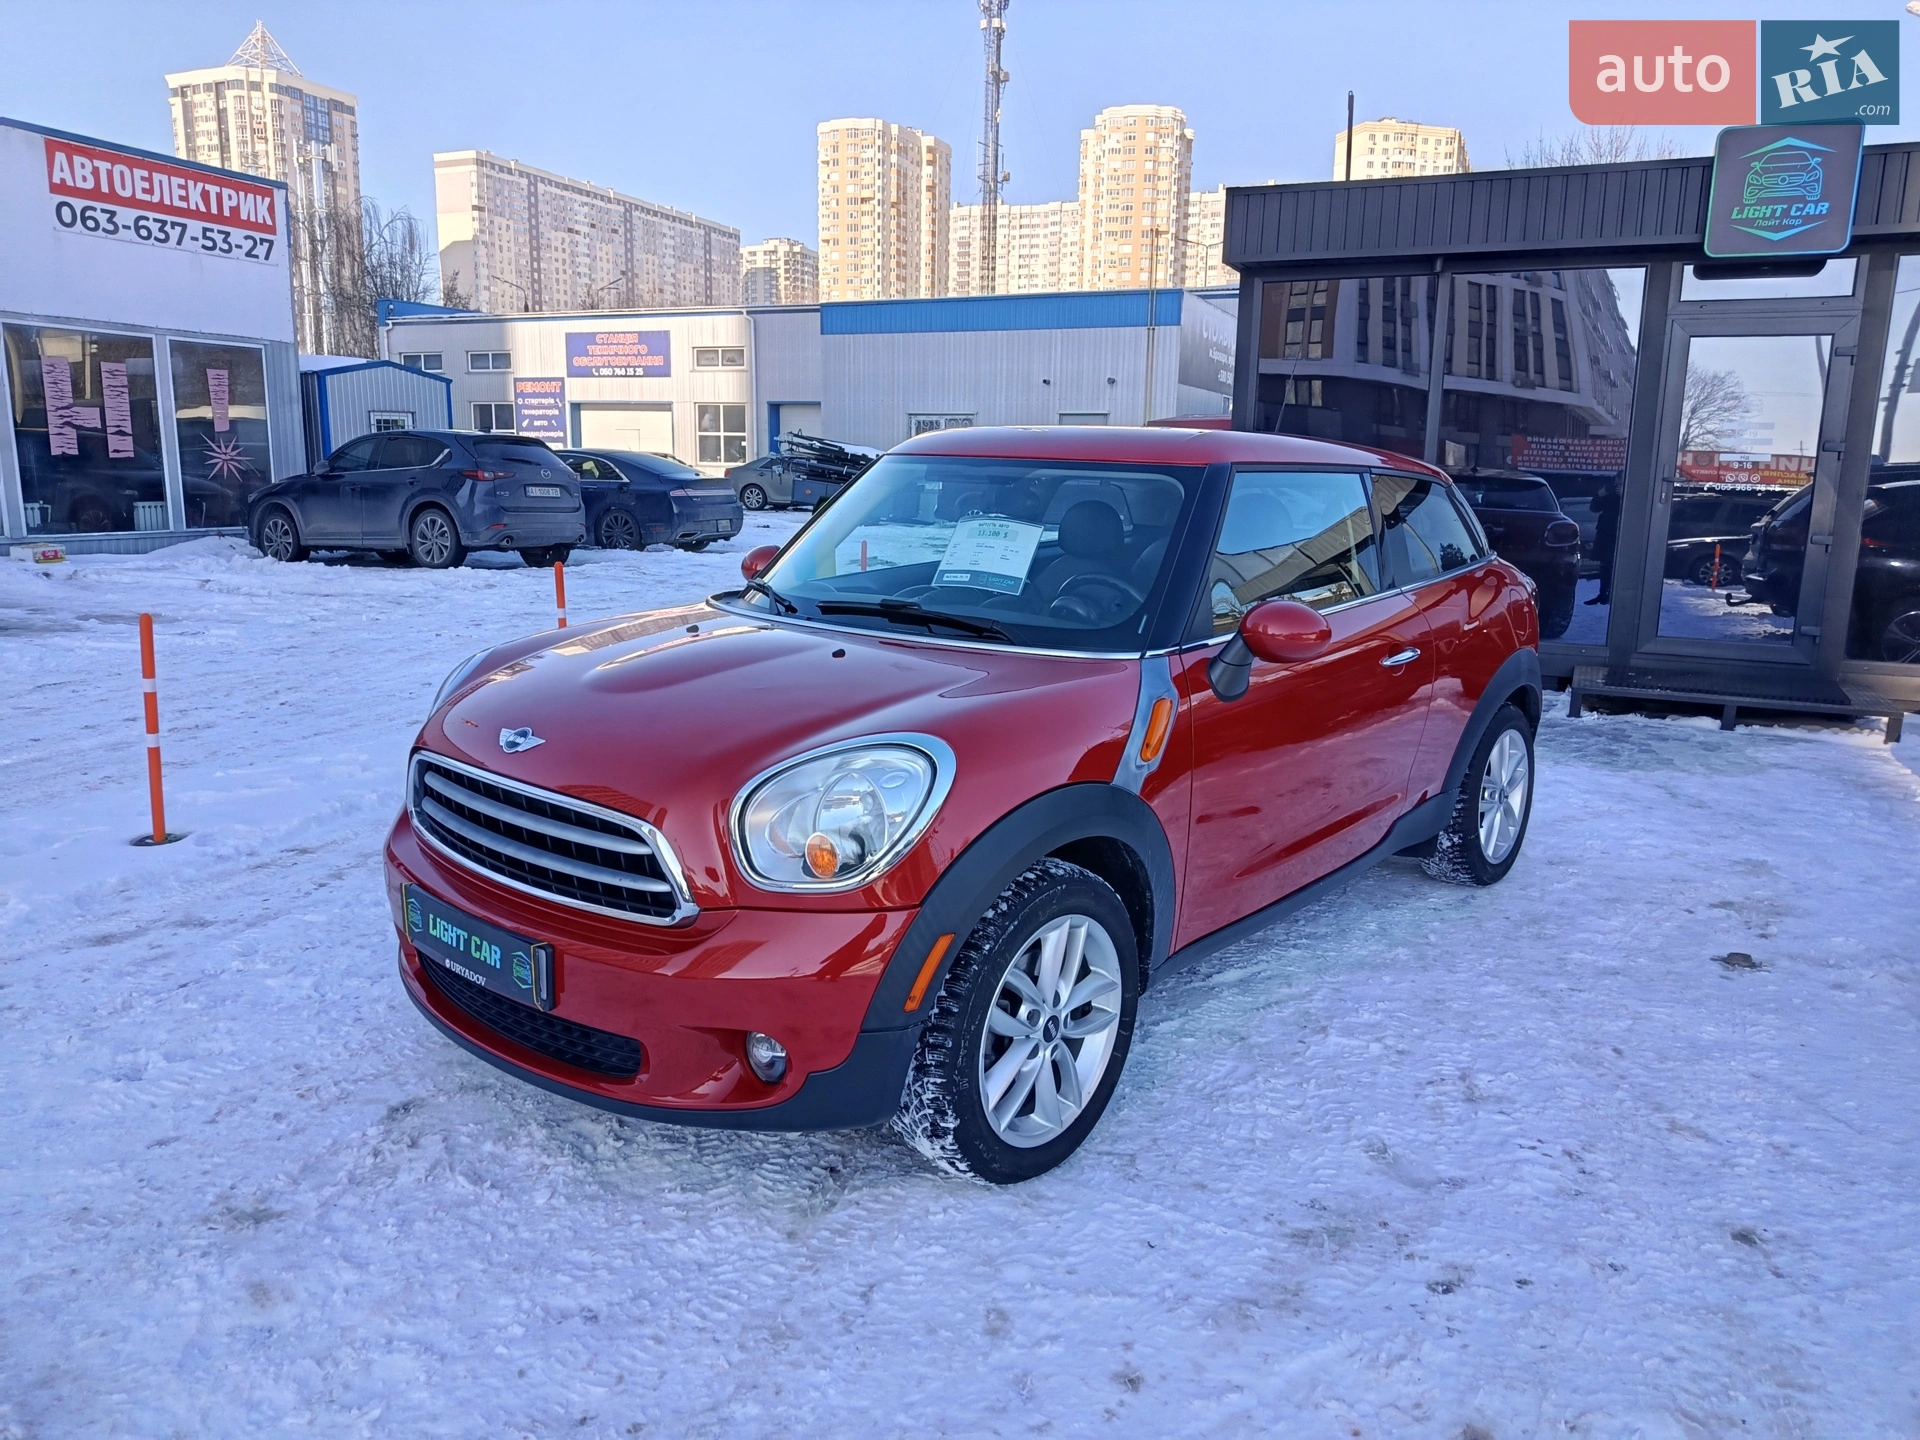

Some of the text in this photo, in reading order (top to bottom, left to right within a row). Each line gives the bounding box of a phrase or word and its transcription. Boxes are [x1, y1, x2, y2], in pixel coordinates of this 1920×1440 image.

[52, 151, 273, 226] АВТОЕЛЕКТРИК
[1730, 202, 1830, 219] LIGHT CAR
[1753, 217, 1802, 227] Лайт Кар
[55, 200, 275, 261] 063-637-53-27
[596, 333, 639, 344] СТАНЦІЯ
[587, 344, 648, 355] ТЕХНІЧНОГО
[573, 355, 664, 366] ОБСЛУГОВУВАННЯ
[516, 381, 562, 393] РЕМОНТ
[525, 396, 555, 405] стартерів
[521, 408, 559, 416] генераторів
[429, 913, 501, 969] LIGHT CAR
[450, 960, 487, 987] URYADOV
